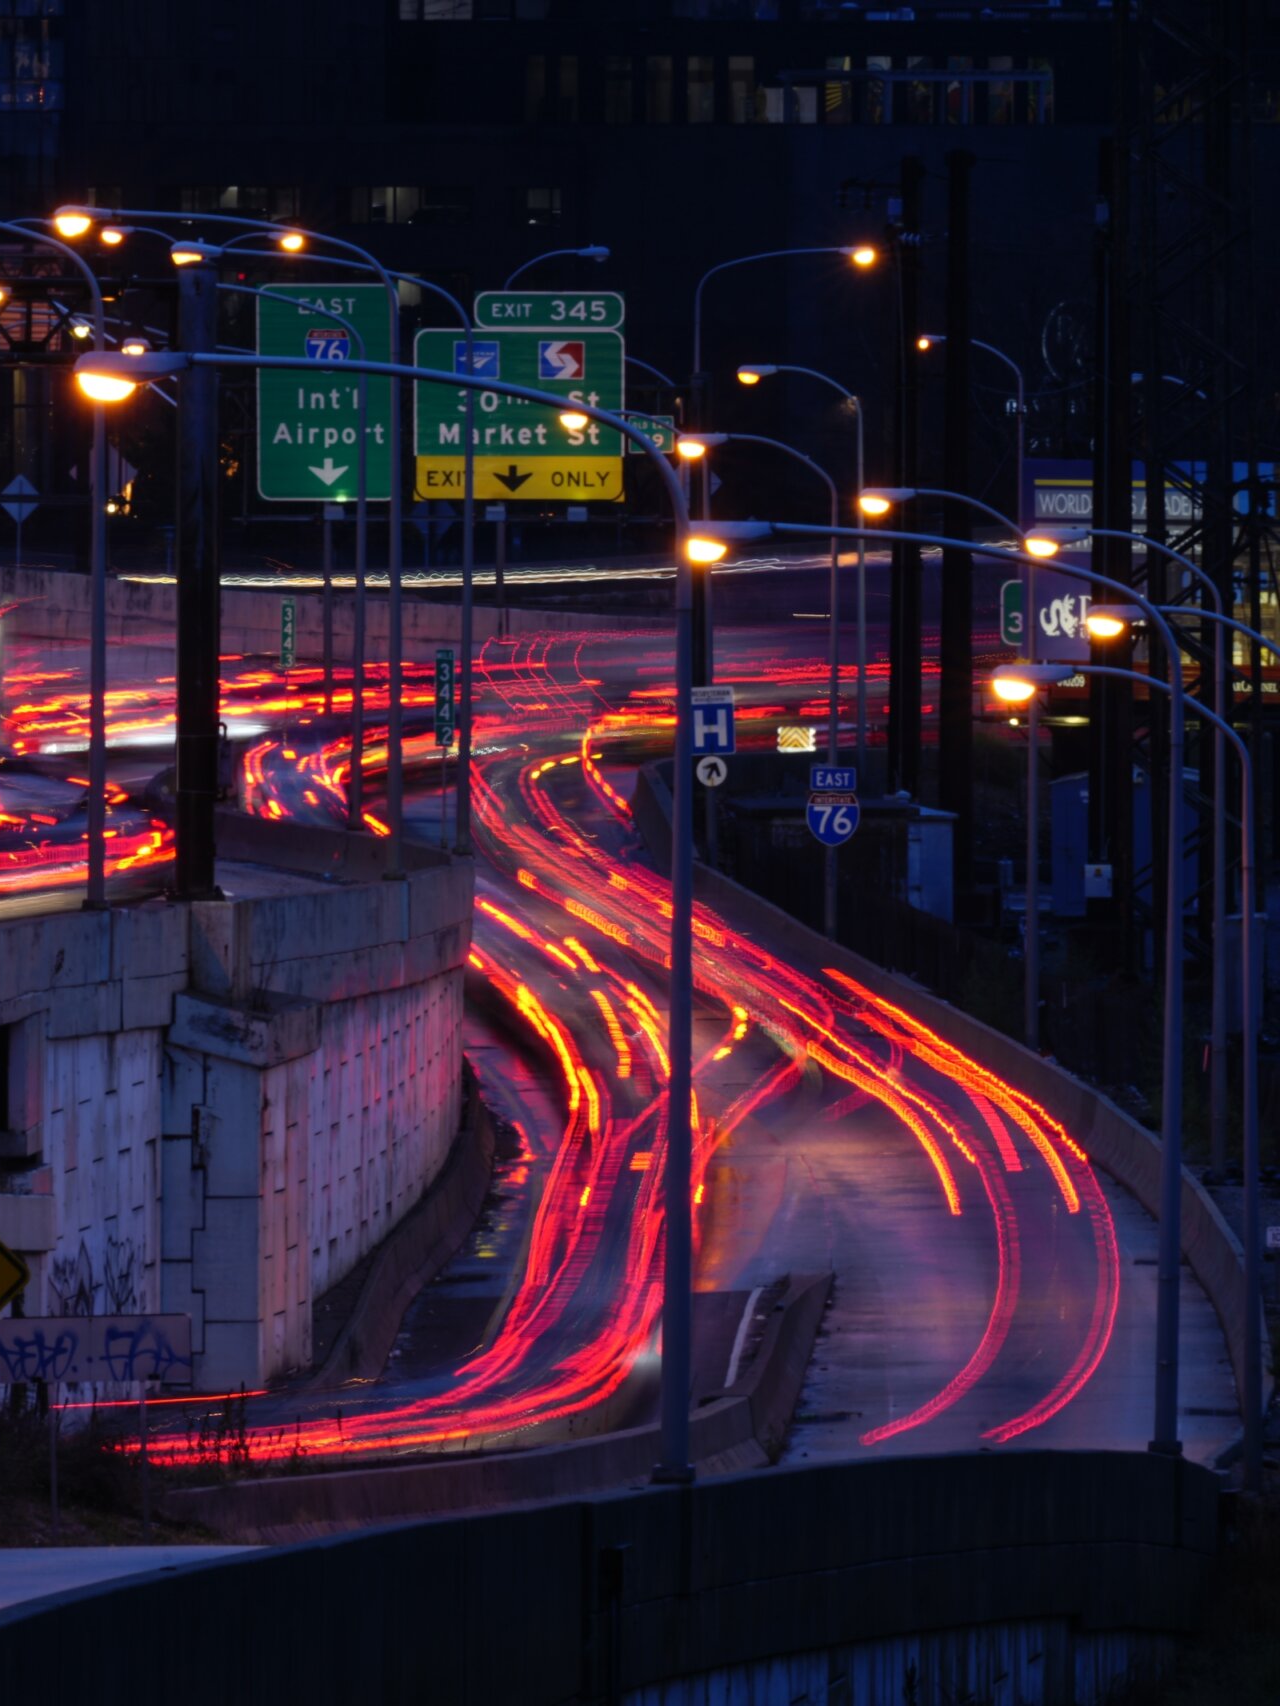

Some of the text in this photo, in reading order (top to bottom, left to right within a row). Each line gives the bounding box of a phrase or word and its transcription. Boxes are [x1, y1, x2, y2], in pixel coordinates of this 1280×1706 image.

[298, 298, 357, 315] EAST
[491, 301, 607, 321] EXIT 345
[308, 340, 345, 361] 76
[438, 422, 600, 446] Market St
[426, 470, 611, 488] EXI ONLY
[693, 708, 729, 748] H
[815, 771, 851, 787] EAST
[812, 805, 853, 836] 76
